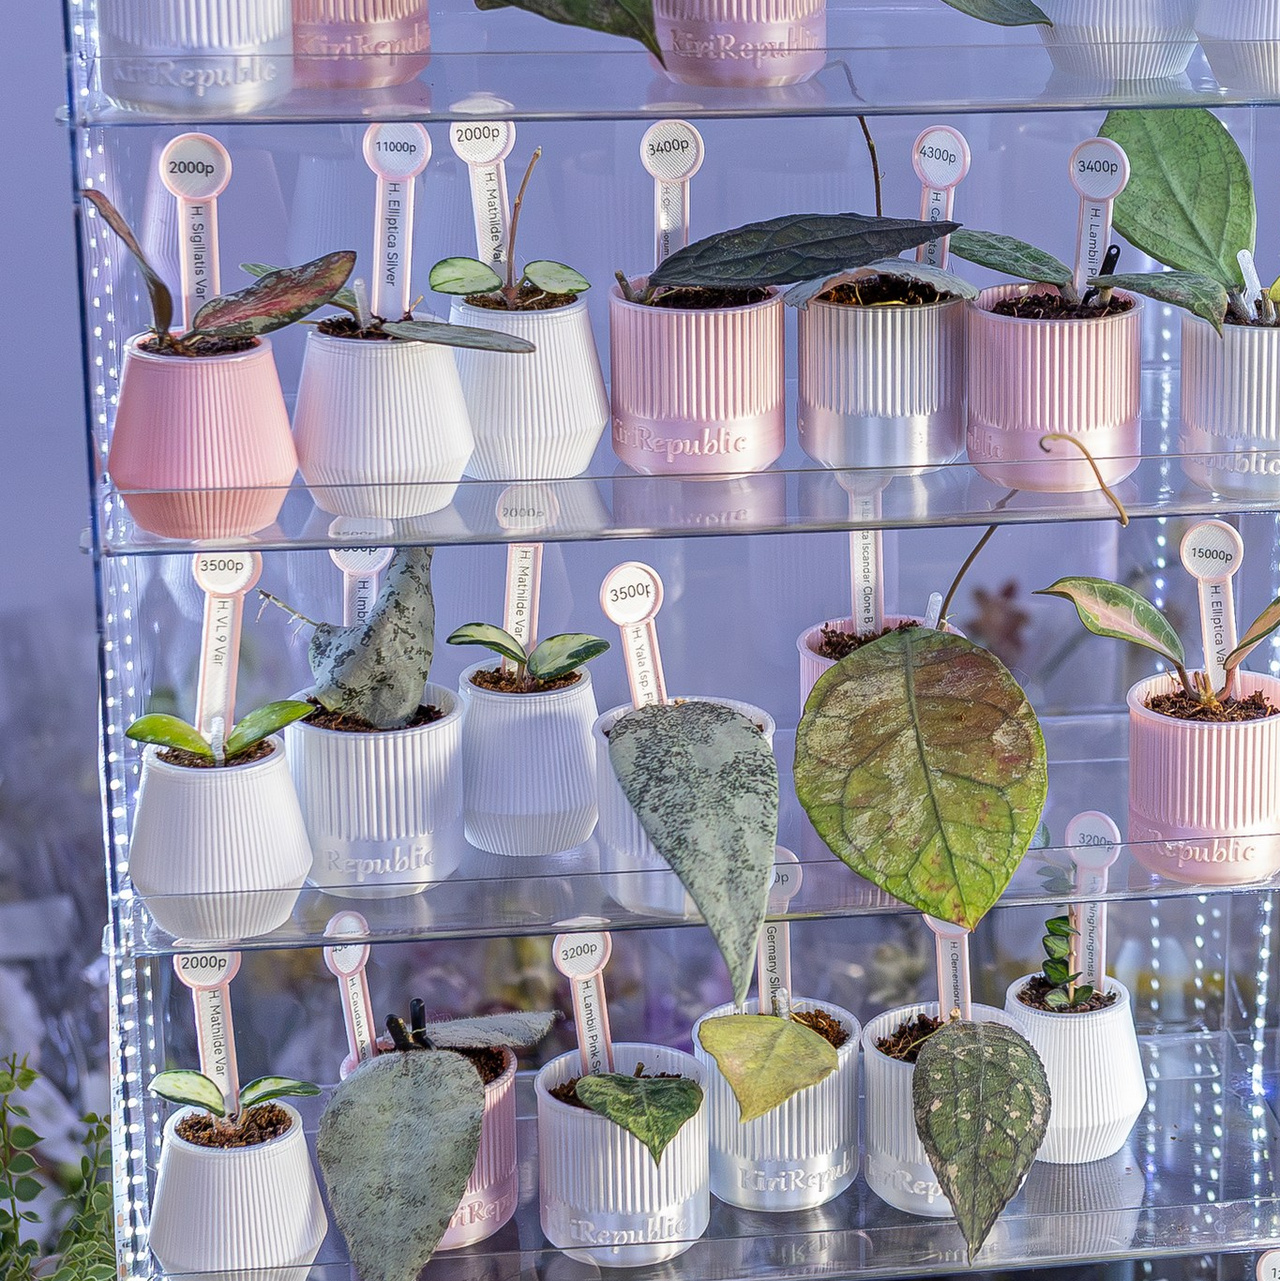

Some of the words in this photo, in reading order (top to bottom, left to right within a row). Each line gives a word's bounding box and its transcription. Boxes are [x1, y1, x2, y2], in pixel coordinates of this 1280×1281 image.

[385, 200, 400, 248] Elliptica
[487, 189, 500, 241] Mathilde
[386, 252, 398, 286] Silver
[492, 244, 503, 264] Var
[195, 279, 207, 300] Var
[516, 566, 529, 616] Mathilde
[515, 620, 525, 638] Var
[1210, 601, 1223, 645] Elliptica
[213, 646, 226, 665] Var
[766, 926, 777, 974] Germany
[210, 1005, 223, 1055] Mathilde
[588, 1035, 598, 1059] Pink
[215, 1057, 226, 1076] Var
